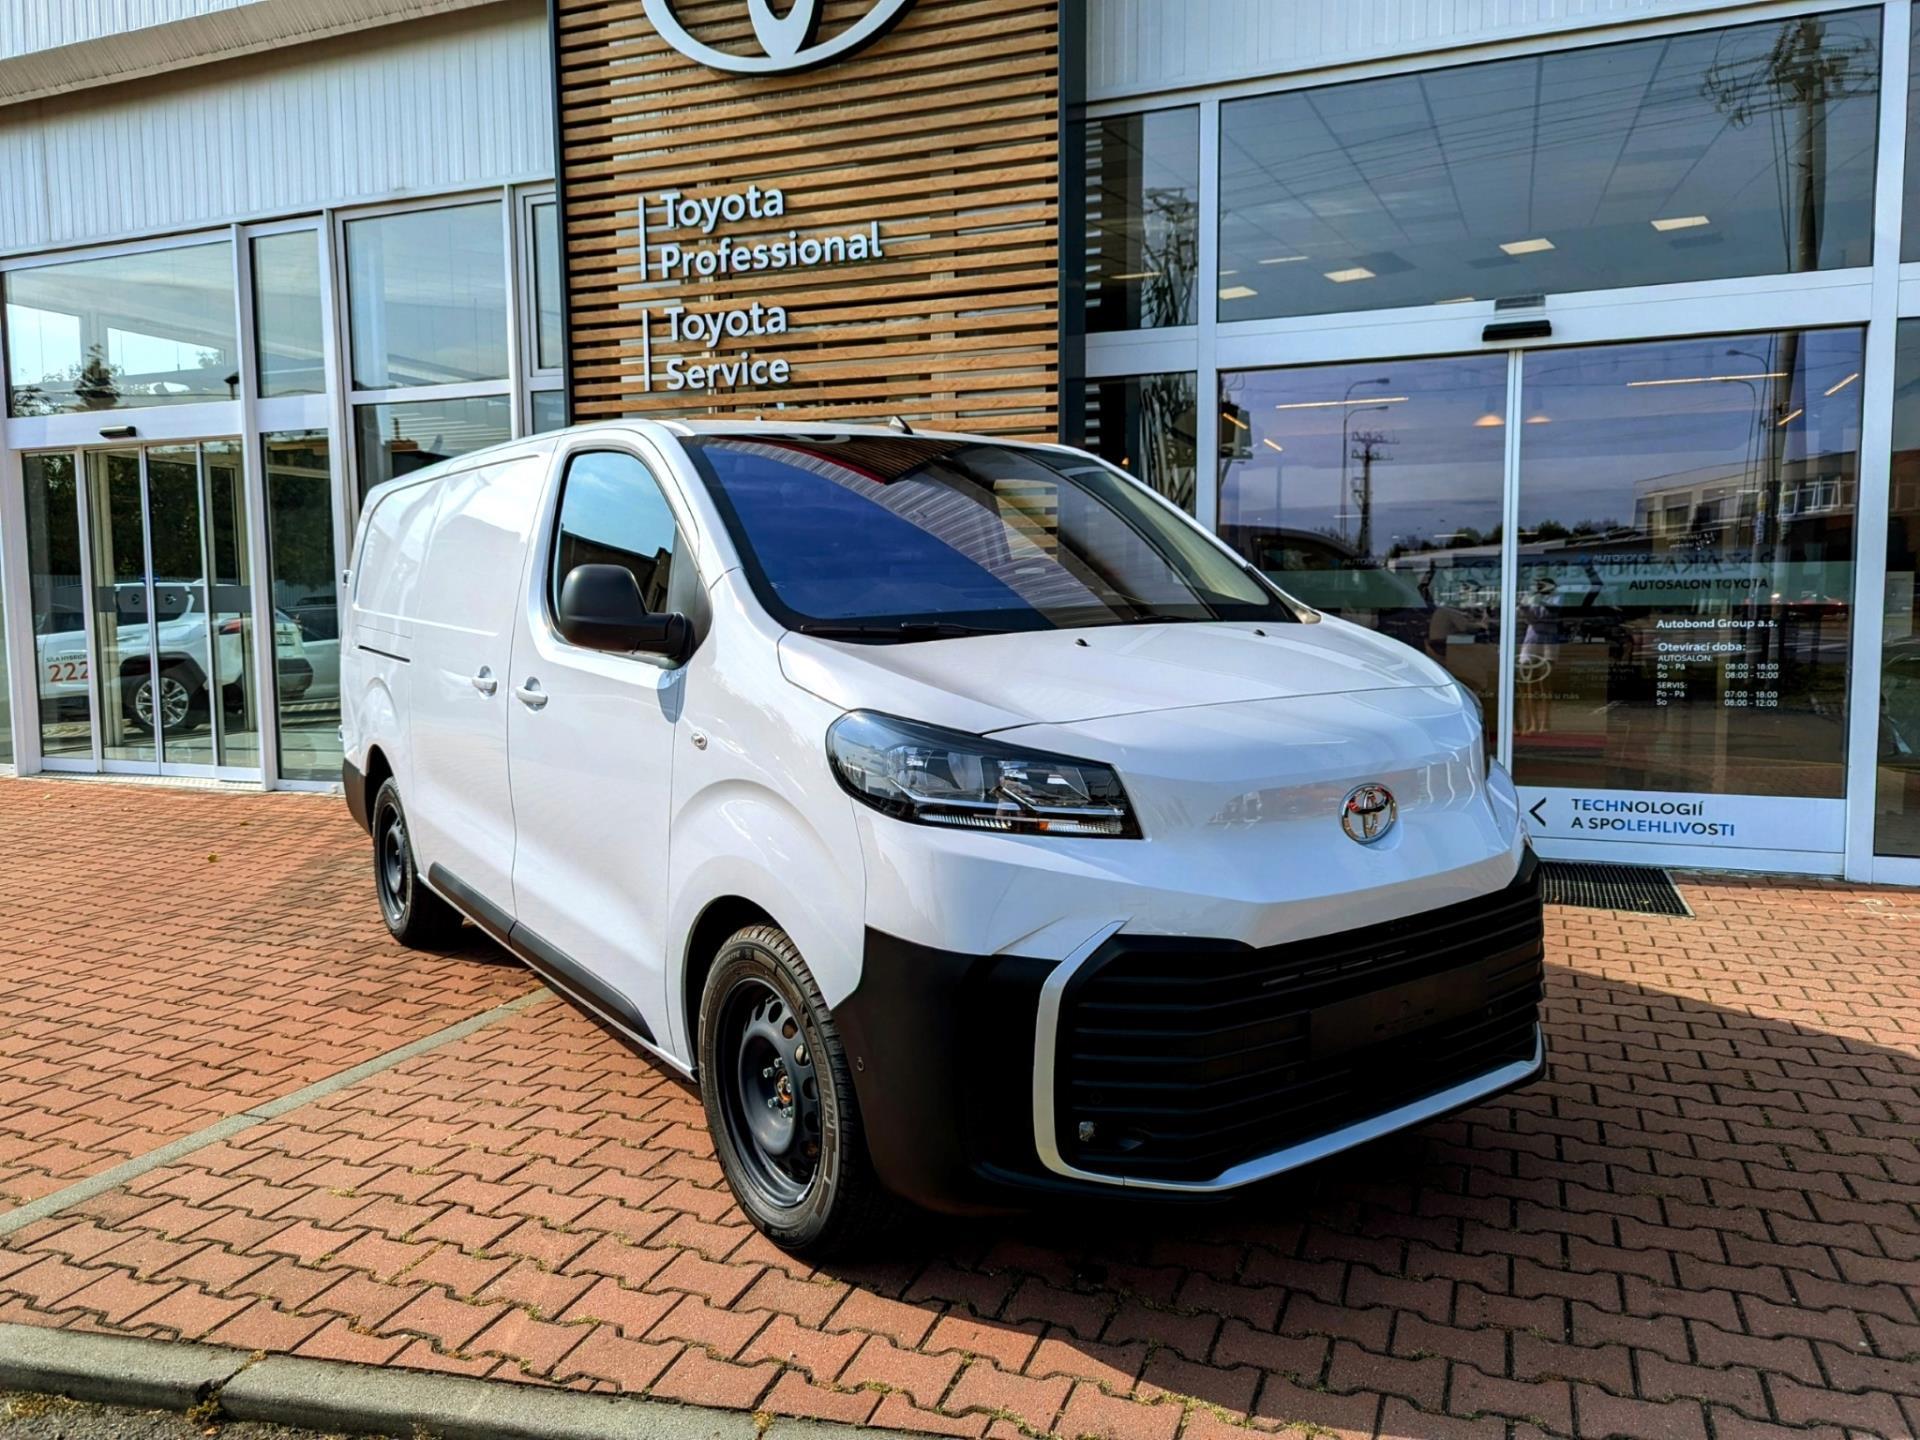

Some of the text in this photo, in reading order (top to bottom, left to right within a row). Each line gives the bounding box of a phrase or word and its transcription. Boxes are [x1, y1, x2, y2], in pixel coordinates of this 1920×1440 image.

[660, 185, 785, 233] Toyota
[661, 221, 883, 279] Professional
[664, 302, 788, 348] Toyota
[666, 352, 791, 390] Service
[1629, 578, 1769, 591] AUTOSALON TOYOTA
[1656, 619, 1778, 630] Autobond Group a.s.
[1658, 642, 1746, 652] Otevírací doba:
[48, 661, 88, 682] 222
[1657, 671, 1668, 679] So
[1756, 671, 1779, 679] 12:00
[1657, 681, 1687, 689] SERVIS:
[1656, 698, 1667, 706] So
[1571, 798, 1704, 816] TECHNOLOGIÍ
[1571, 816, 1735, 837] A SPOLEHLIVOSTI
